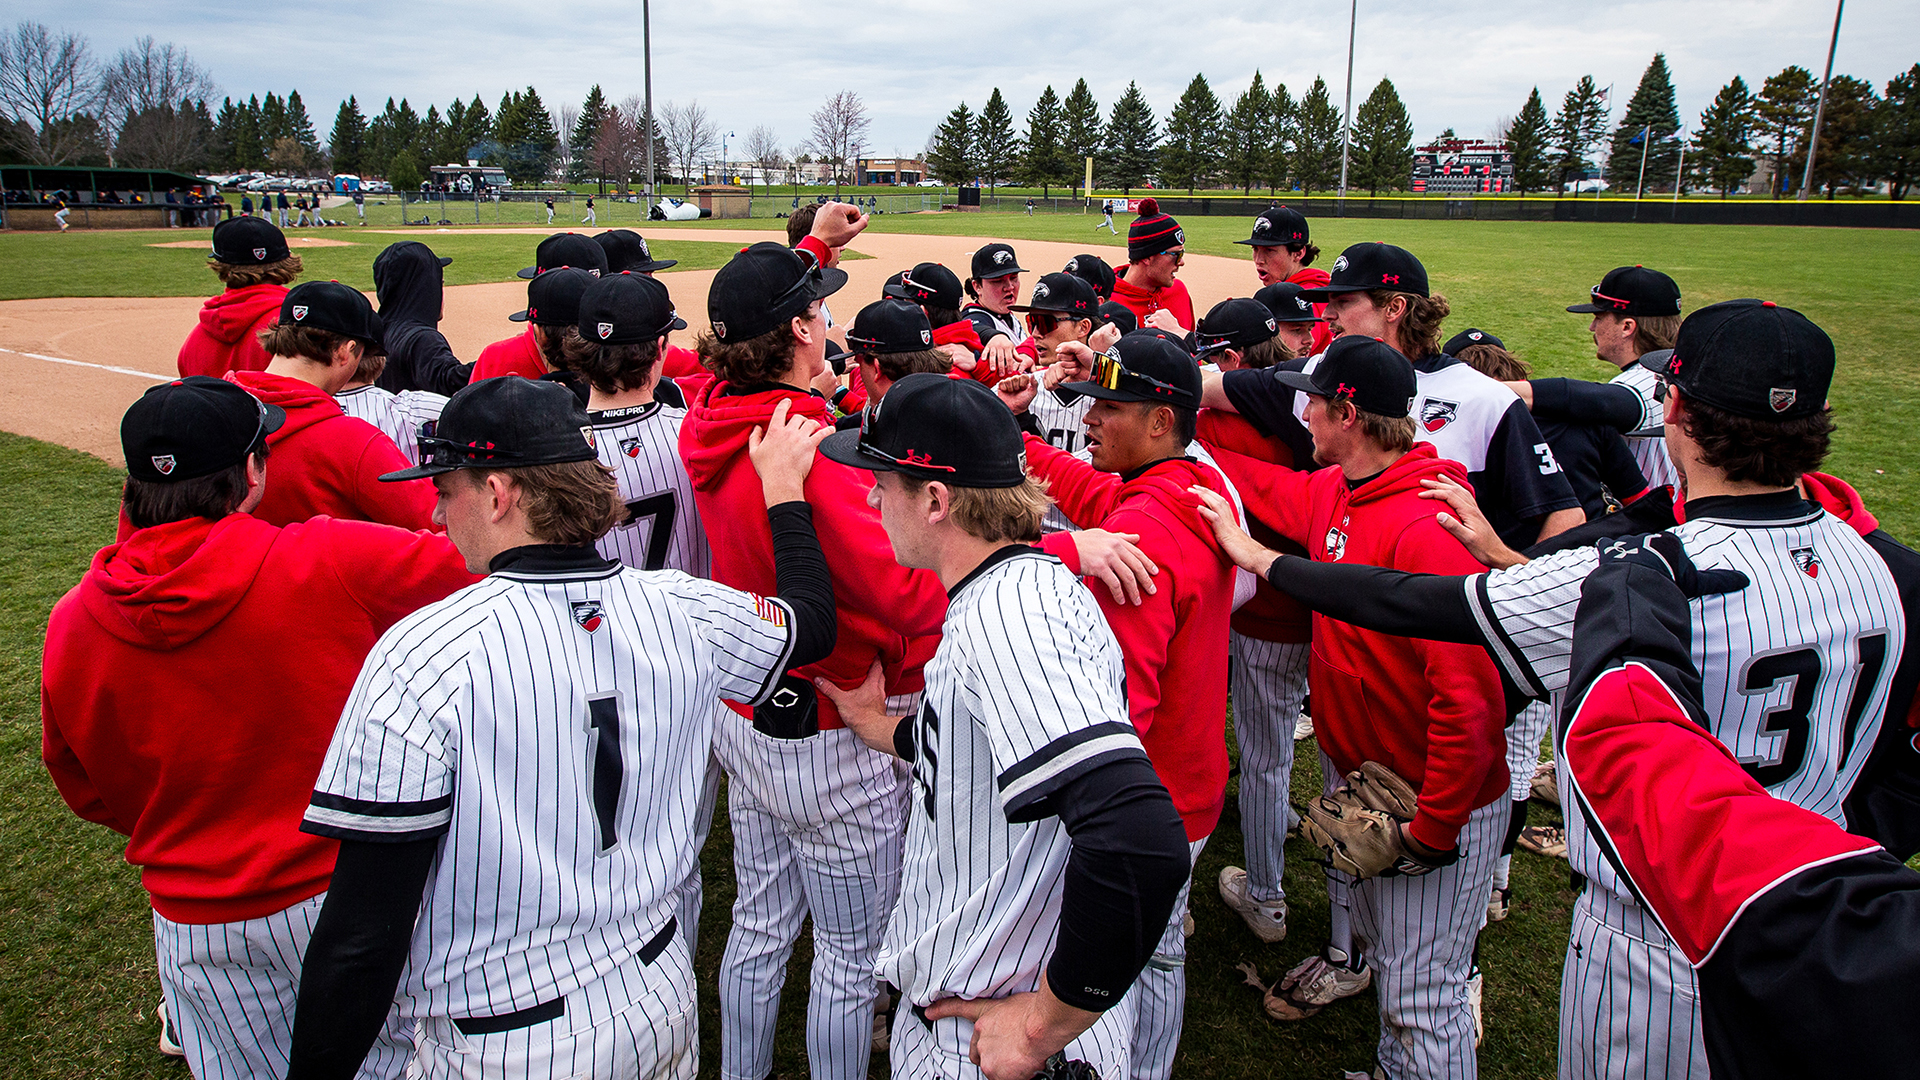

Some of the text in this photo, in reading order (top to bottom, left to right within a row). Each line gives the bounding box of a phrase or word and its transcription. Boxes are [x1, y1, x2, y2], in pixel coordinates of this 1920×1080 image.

[602, 406, 645, 418] NIKE PRO
[1533, 442, 1564, 475] 3
[617, 487, 680, 571] 7
[1736, 626, 1891, 790] 31
[582, 689, 630, 859] 1
[1084, 986, 1109, 997] DSG
